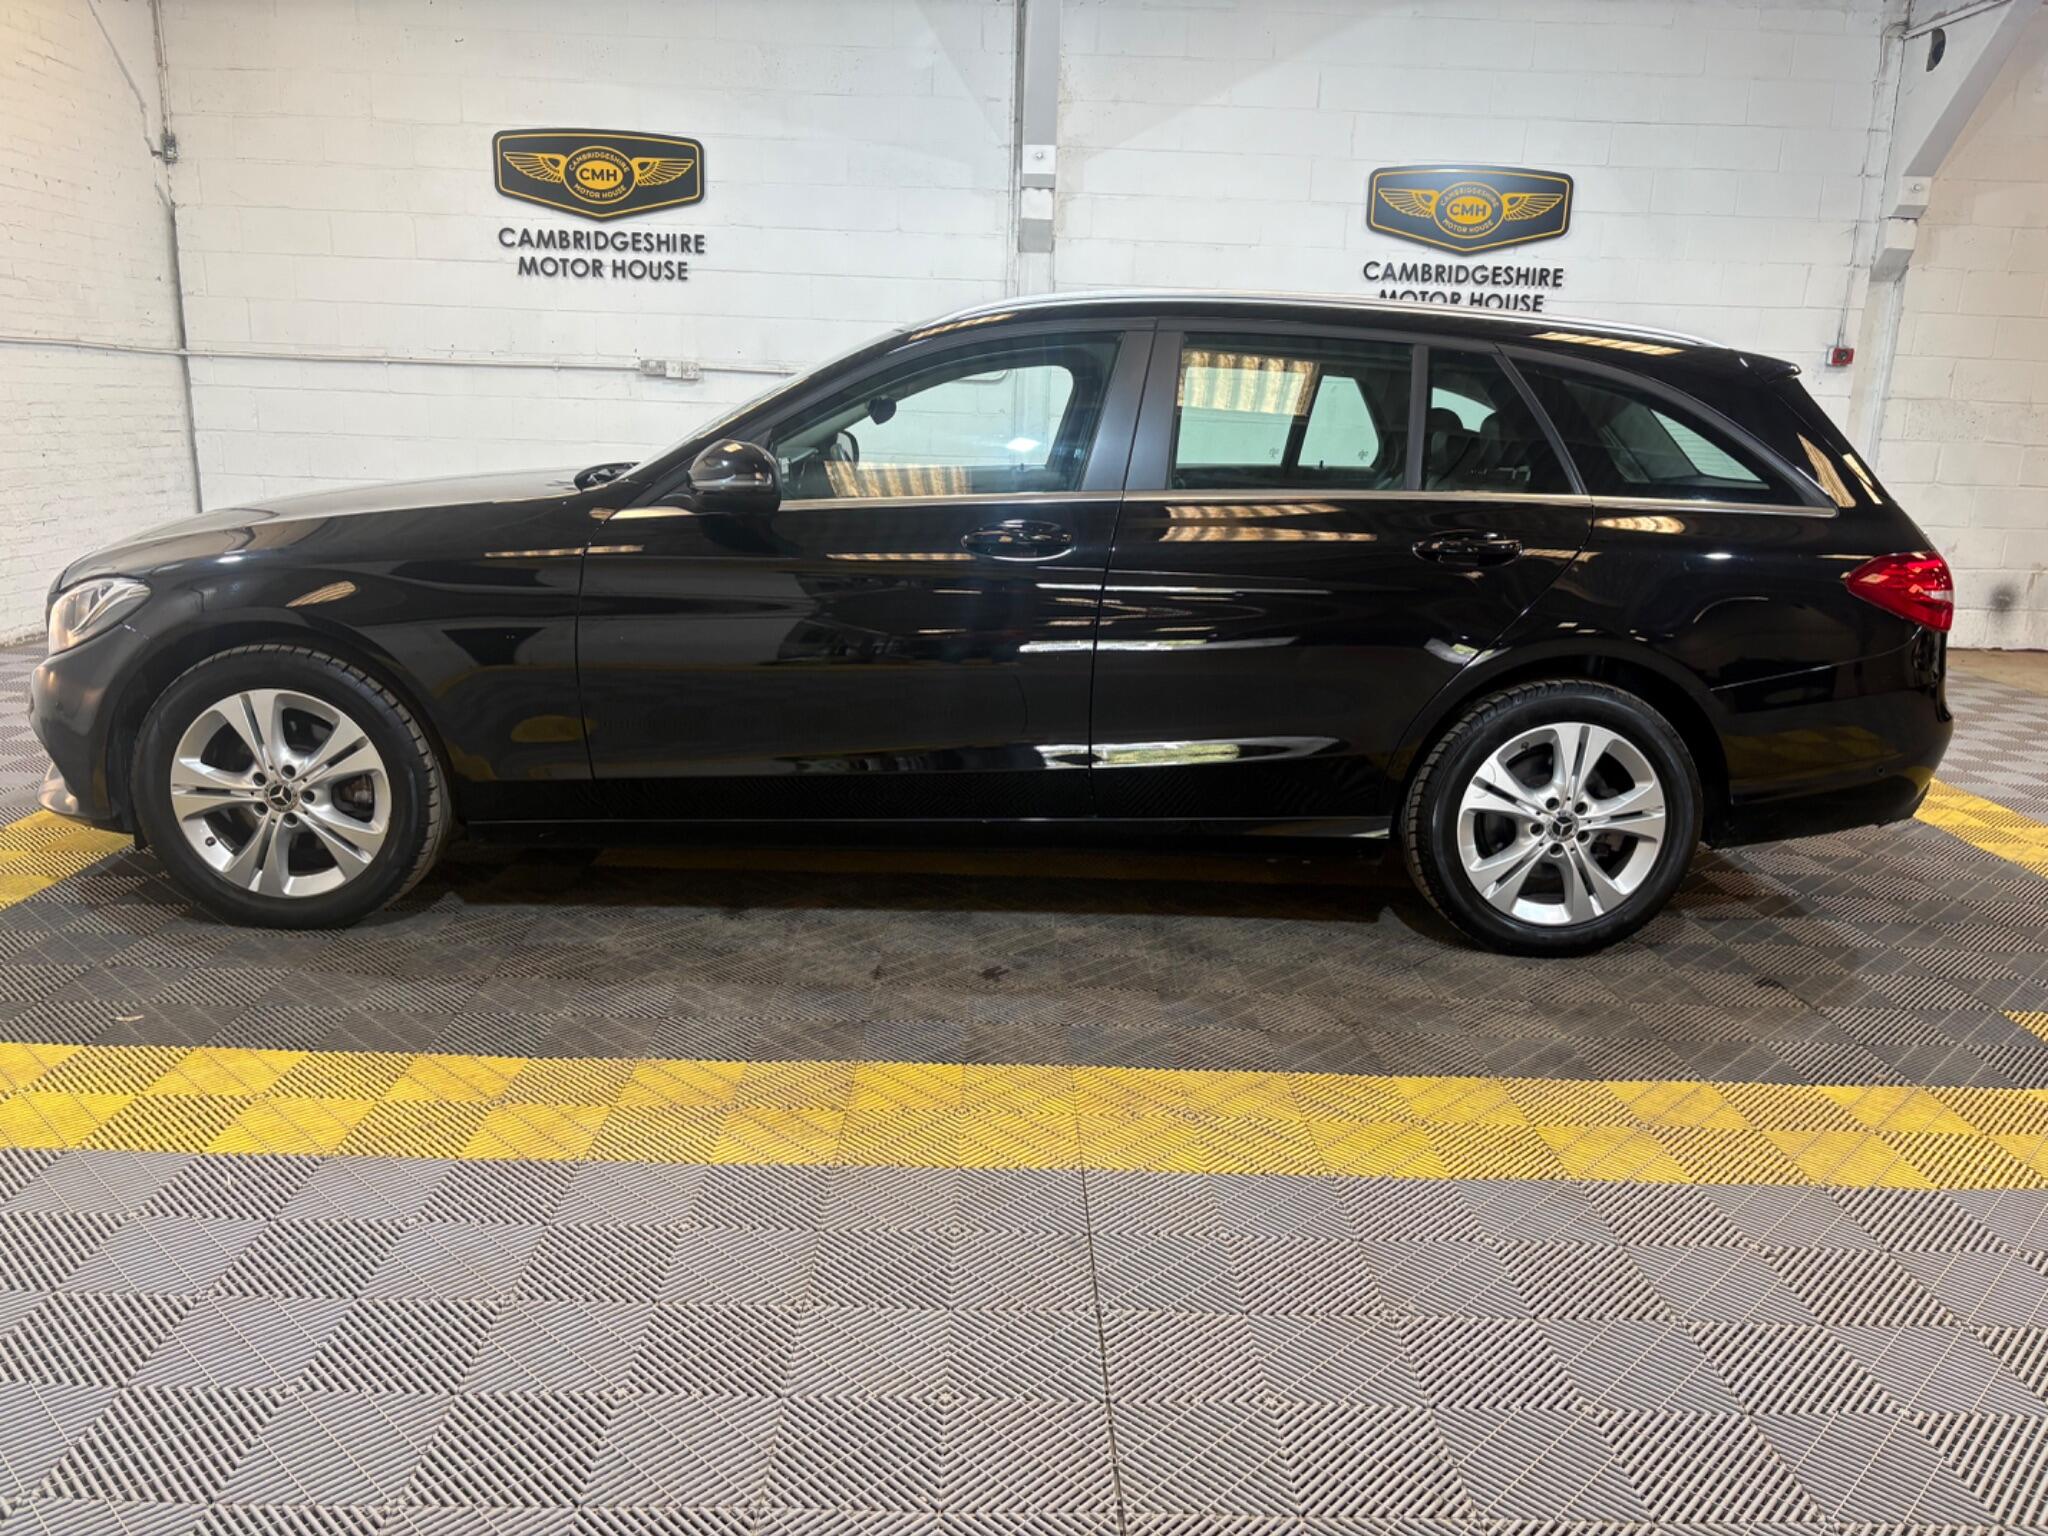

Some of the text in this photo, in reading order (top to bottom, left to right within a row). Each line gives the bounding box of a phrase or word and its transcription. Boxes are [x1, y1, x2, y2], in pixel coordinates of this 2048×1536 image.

[569, 151, 630, 173] CAMBRIDGESHIRE
[579, 168, 618, 181] CMH
[573, 183, 627, 198] MOTOR HOUSE
[1450, 203, 1487, 217] CMH
[1442, 218, 1494, 233] MOTOR HOUSE
[499, 228, 705, 254] CAMBRIDGESHIRE
[518, 257, 688, 280] MOTOR HOUSE
[1363, 261, 1564, 287] CAMBRIDGESHIRE
[1470, 292, 1544, 313] HOUSE
